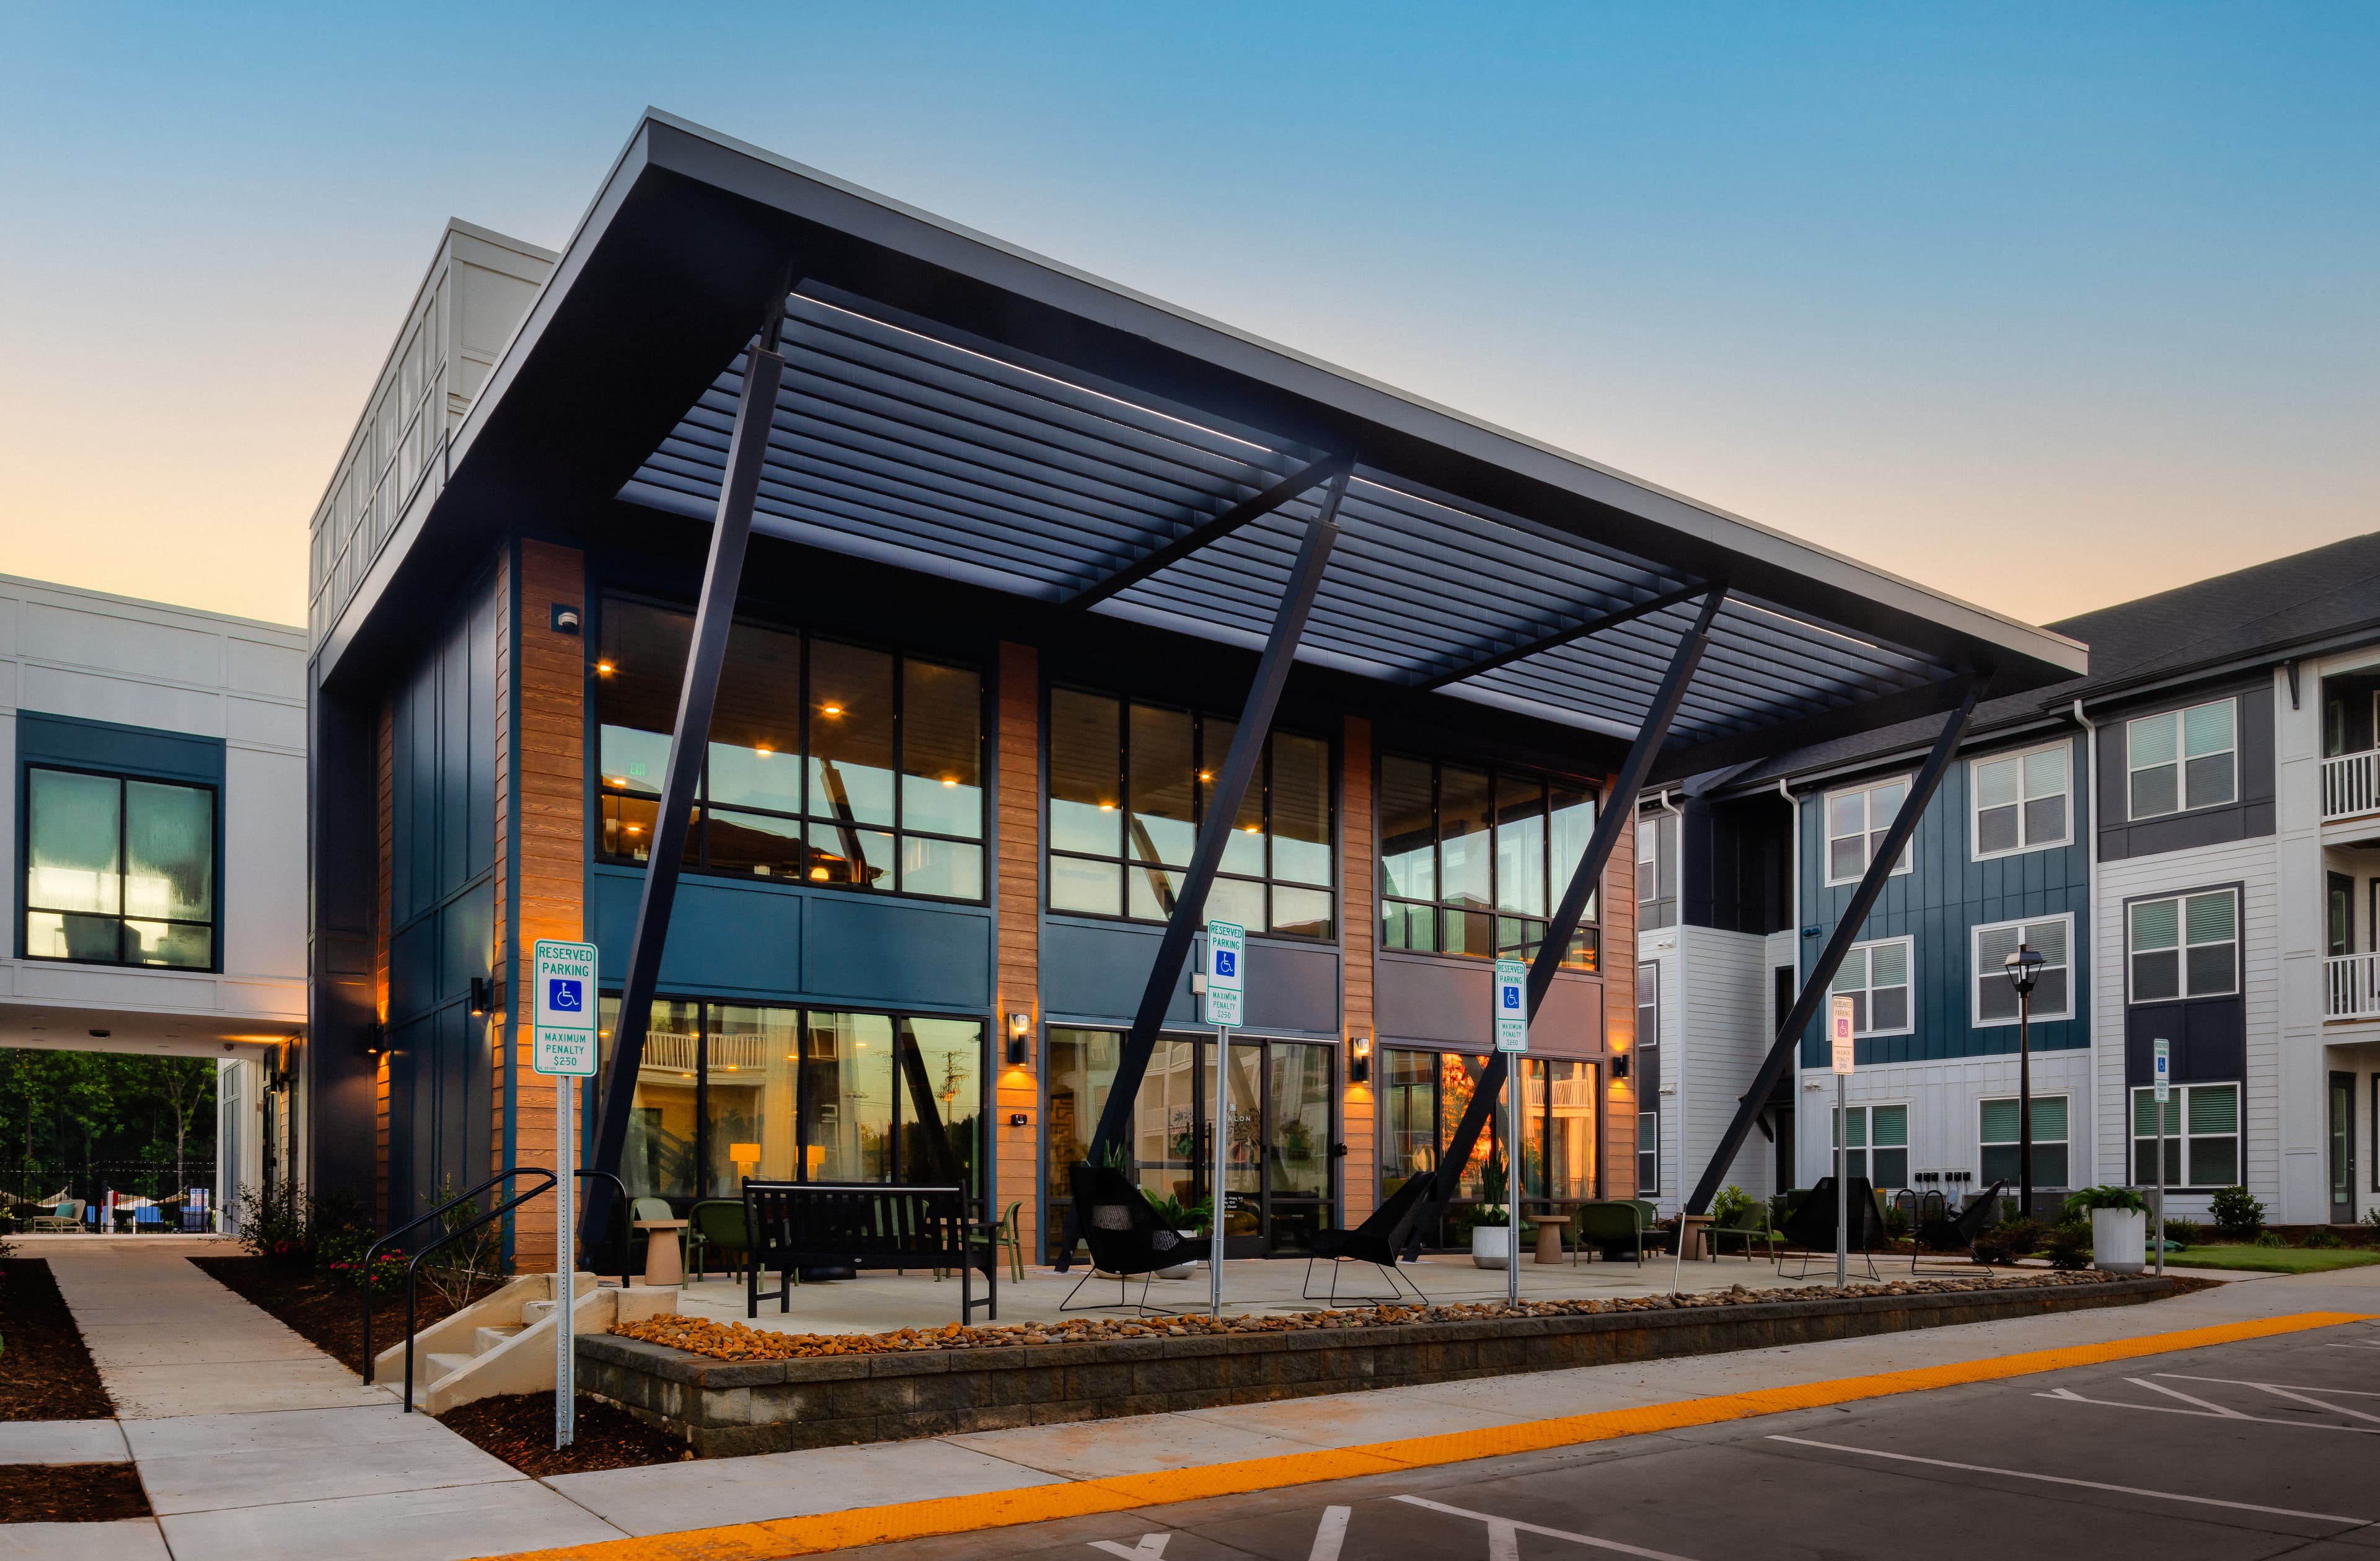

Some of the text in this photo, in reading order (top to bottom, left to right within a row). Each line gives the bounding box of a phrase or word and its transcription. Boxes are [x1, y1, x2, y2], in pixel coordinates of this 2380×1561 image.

[630, 763, 645, 776] EXIT
[1210, 924, 1242, 939] RESERVED
[1212, 937, 1240, 950] PARKING
[539, 946, 593, 962] RESERVED
[542, 962, 589, 977] PARKING
[1498, 964, 1523, 974] RESERVED
[1500, 975, 1522, 984] PARKING
[1212, 992, 1237, 1001] MAXIMUM
[1213, 1001, 1236, 1010] PENALTY
[1834, 1000, 1852, 1009] RESERVED
[1217, 1010, 1231, 1019] $250
[545, 1032, 586, 1043] MAXIMUM
[546, 1045, 584, 1055] PENALTY
[553, 1055, 577, 1066] $250
